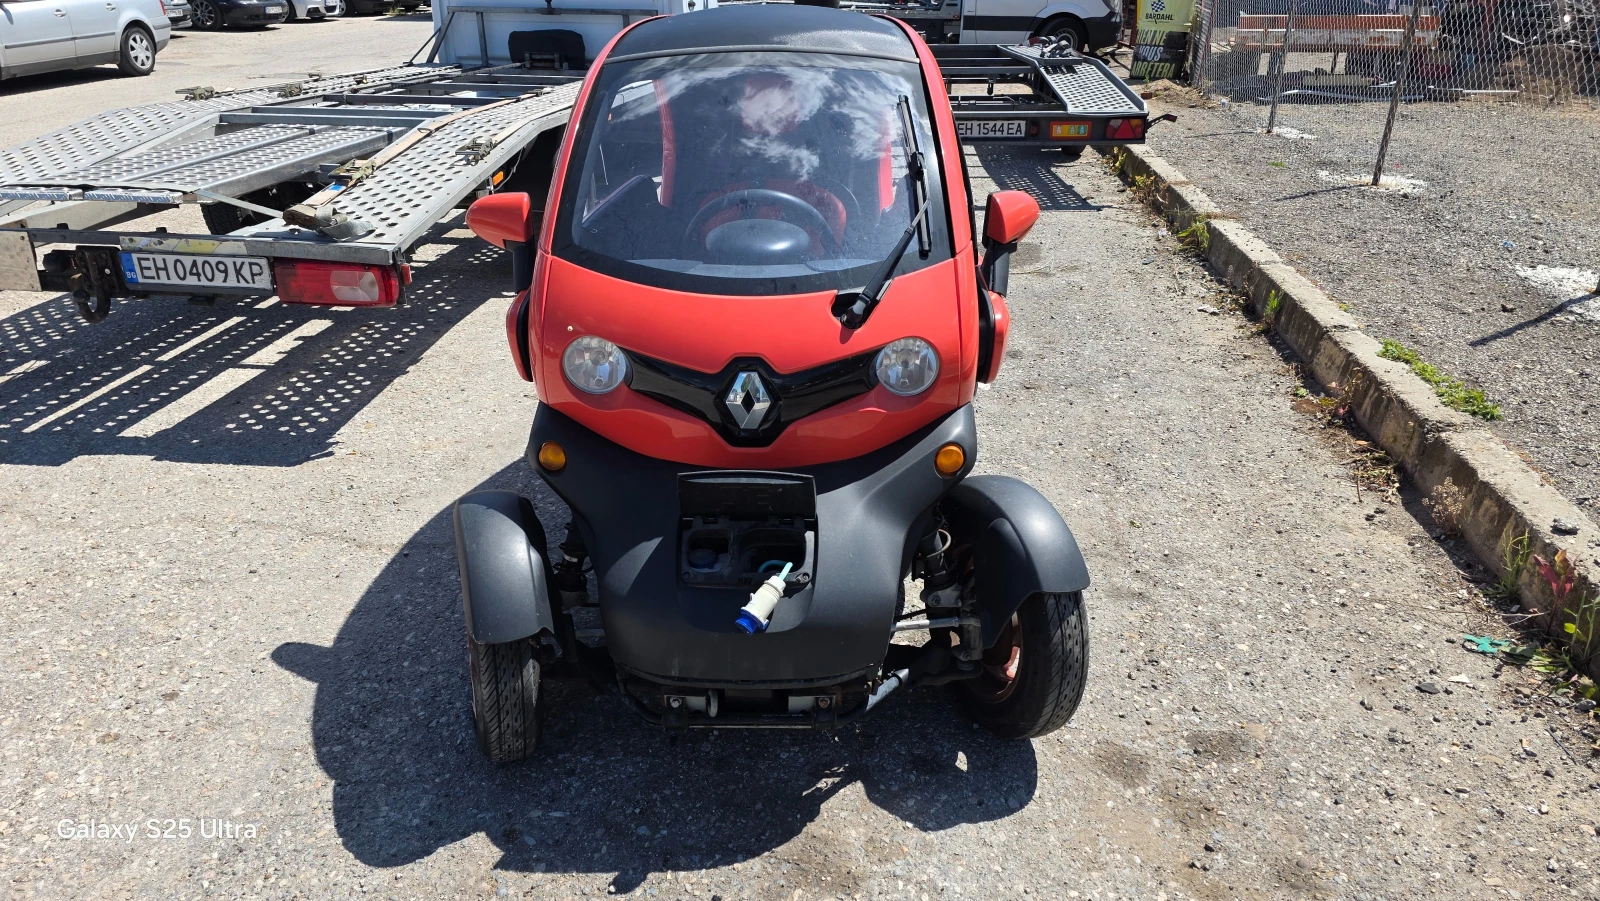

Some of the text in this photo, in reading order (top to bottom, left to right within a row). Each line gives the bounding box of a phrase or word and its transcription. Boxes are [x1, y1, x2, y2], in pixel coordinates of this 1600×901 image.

[1152, 30, 1167, 46] NE
[1139, 45, 1164, 61] VOUS
[957, 122, 1023, 136] EH 1544 EA
[126, 271, 137, 279] BG
[136, 257, 264, 285] EH 0409 KP
